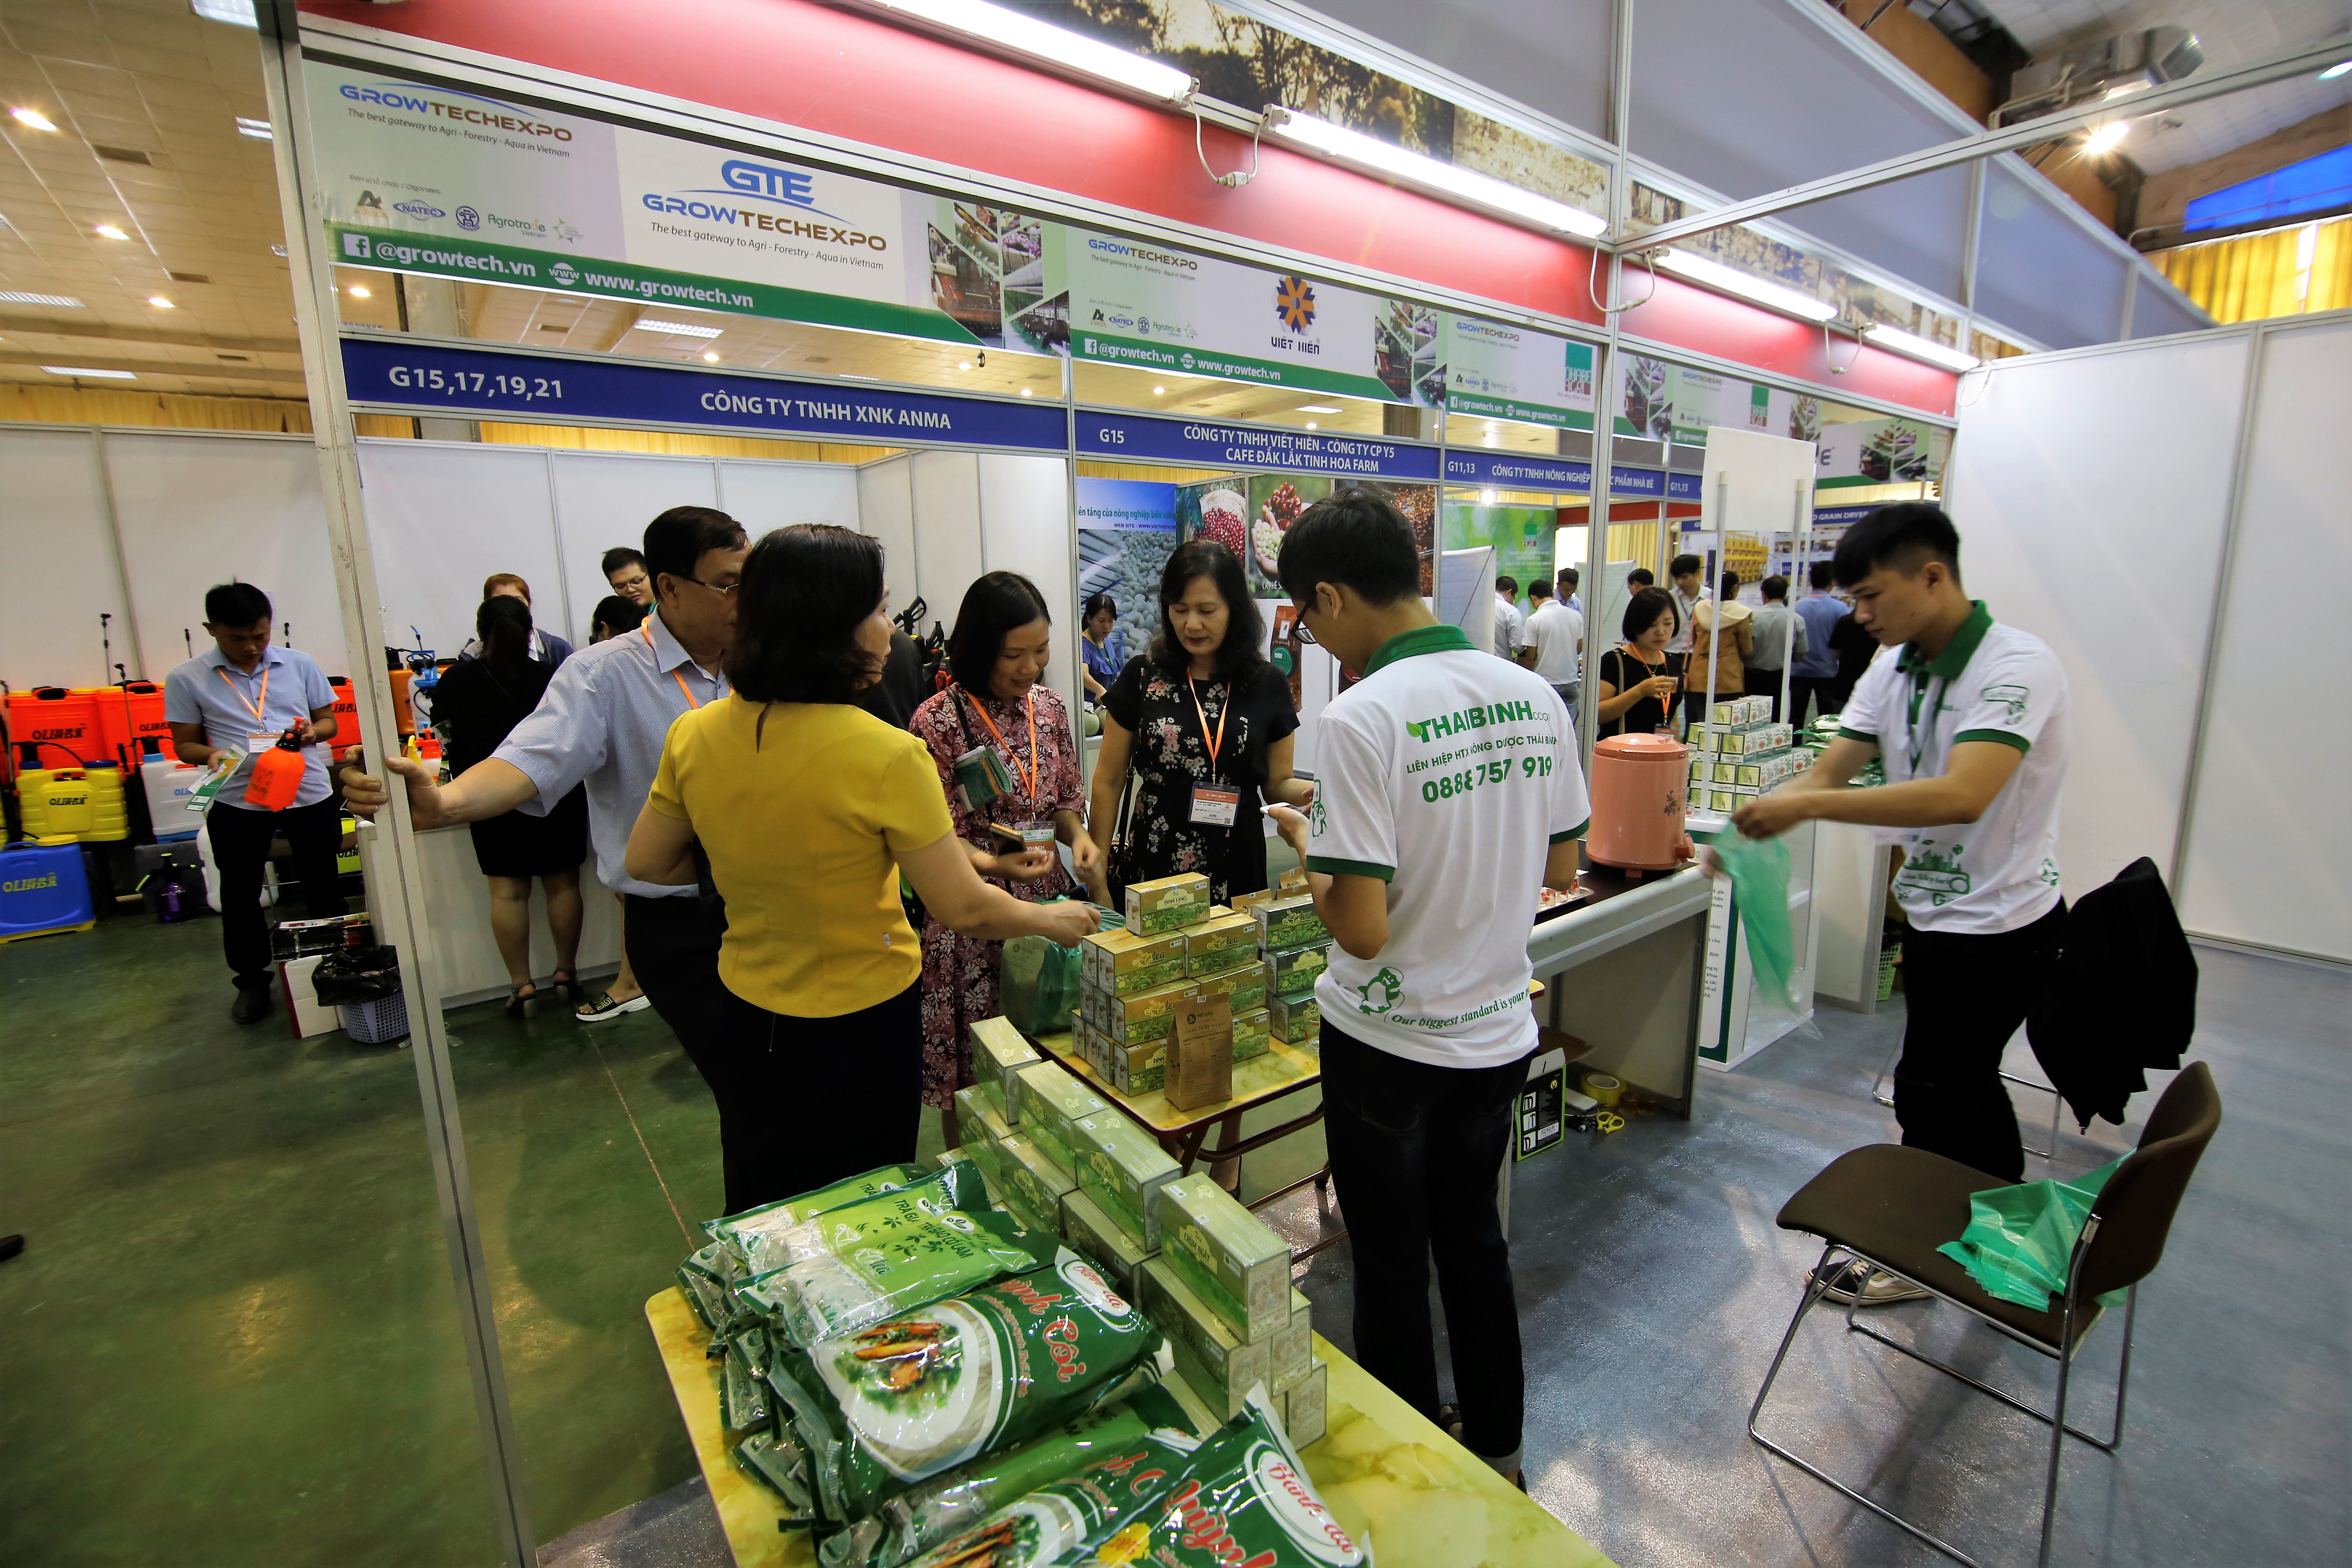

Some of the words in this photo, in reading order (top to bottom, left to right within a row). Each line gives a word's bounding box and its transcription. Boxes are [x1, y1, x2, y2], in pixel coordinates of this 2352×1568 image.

[340, 85, 573, 141] GROWTECHEXPO
[348, 108, 364, 119] The
[367, 110, 386, 123] best
[387, 116, 426, 131] gateway
[429, 122, 438, 132] to
[439, 124, 457, 137] Agri
[464, 130, 497, 145] Forestry
[504, 138, 525, 150] Aqua
[527, 141, 535, 151] in
[537, 144, 570, 157] Vietnam
[722, 159, 815, 205] GTE
[402, 205, 437, 216] NATEC
[487, 213, 546, 232] Agrotrade
[643, 194, 887, 251] GROWTECHEXPO
[651, 222, 669, 235] The
[671, 224, 691, 239] best
[693, 230, 734, 248] gateway
[736, 236, 747, 247] to
[748, 238, 767, 252] Agri
[775, 243, 809, 259] Forestry
[815, 251, 839, 263] Aqua
[840, 254, 848, 263] in
[850, 257, 884, 270] Vietnam
[1088, 239, 1197, 271] GROWTECHEXPO
[376, 241, 536, 277] @growtech.vn
[584, 271, 755, 308] www.growtech.vn
[1456, 322, 1520, 341] GROWTECHEXPO
[1099, 343, 1174, 364] @growtech.vn
[1197, 361, 1281, 381] www.growtech.vn
[388, 366, 564, 400] G15,17,19,21
[701, 390, 763, 414] CÔNG
[766, 398, 792, 416] TY
[795, 400, 851, 421] TNHH
[856, 405, 895, 424] XNK
[897, 409, 952, 429] ANMA
[1516, 408, 1566, 422] www.growtech.vn
[1099, 429, 1124, 444] G15
[1184, 423, 1218, 442] CÔNG
[1220, 429, 1235, 443] TY
[1237, 431, 1268, 447] TNHH
[1327, 438, 1355, 455] CÔNG
[1356, 443, 1369, 456] TY
[1370, 444, 1382, 456] CP
[1383, 446, 1395, 458] Y5
[1226, 447, 1254, 462] CAFE
[1256, 446, 1280, 464] ĐẮK
[1282, 448, 1302, 466] LẮK
[1304, 454, 1327, 468] TINH
[1330, 456, 1351, 470] HOA
[1354, 459, 1379, 472] FARM
[1448, 461, 1476, 475] G11,13
[1491, 464, 1513, 477] CÔNG
[1514, 467, 1524, 477] TY
[1525, 468, 1544, 479] TNHH
[1545, 469, 1565, 481] NÔNG
[1567, 471, 1590, 484] NGHIỆP
[1615, 473, 1632, 487] PHẨM
[1633, 476, 1646, 488] NHÀ
[1670, 481, 1689, 493] G11,13
[1087, 507, 1101, 518] tảng
[1102, 508, 1112, 516] của
[1114, 509, 1129, 519] nông
[1130, 508, 1150, 520] nghiệp
[1819, 512, 1843, 521] GRAIN
[1268, 580, 1278, 589] PHÊ
[1406, 760, 1428, 774] LIÊN
[1432, 753, 1452, 767] HIỆP
[1455, 749, 1470, 760] HTX
[1496, 736, 1524, 749] DƯỢC
[1527, 733, 1544, 744] THÁI
[1476, 759, 1512, 786] 757
[1522, 756, 1552, 778] 919
[1226, 934, 1239, 945] tea
[1152, 950, 1166, 961] tea
[1235, 979, 1248, 989] tea
[1391, 1014, 1417, 1026] Our
[1418, 1015, 1459, 1029] biggest
[1461, 1000, 1499, 1023] standard
[1499, 998, 1508, 1009] is
[1508, 991, 1525, 1009] your
[894, 1199, 915, 1214] TRÀ
[1184, 1232, 1199, 1253] CHÙM
[1043, 1319, 1087, 1382] Côi
[1268, 1462, 1326, 1517] Bánh
